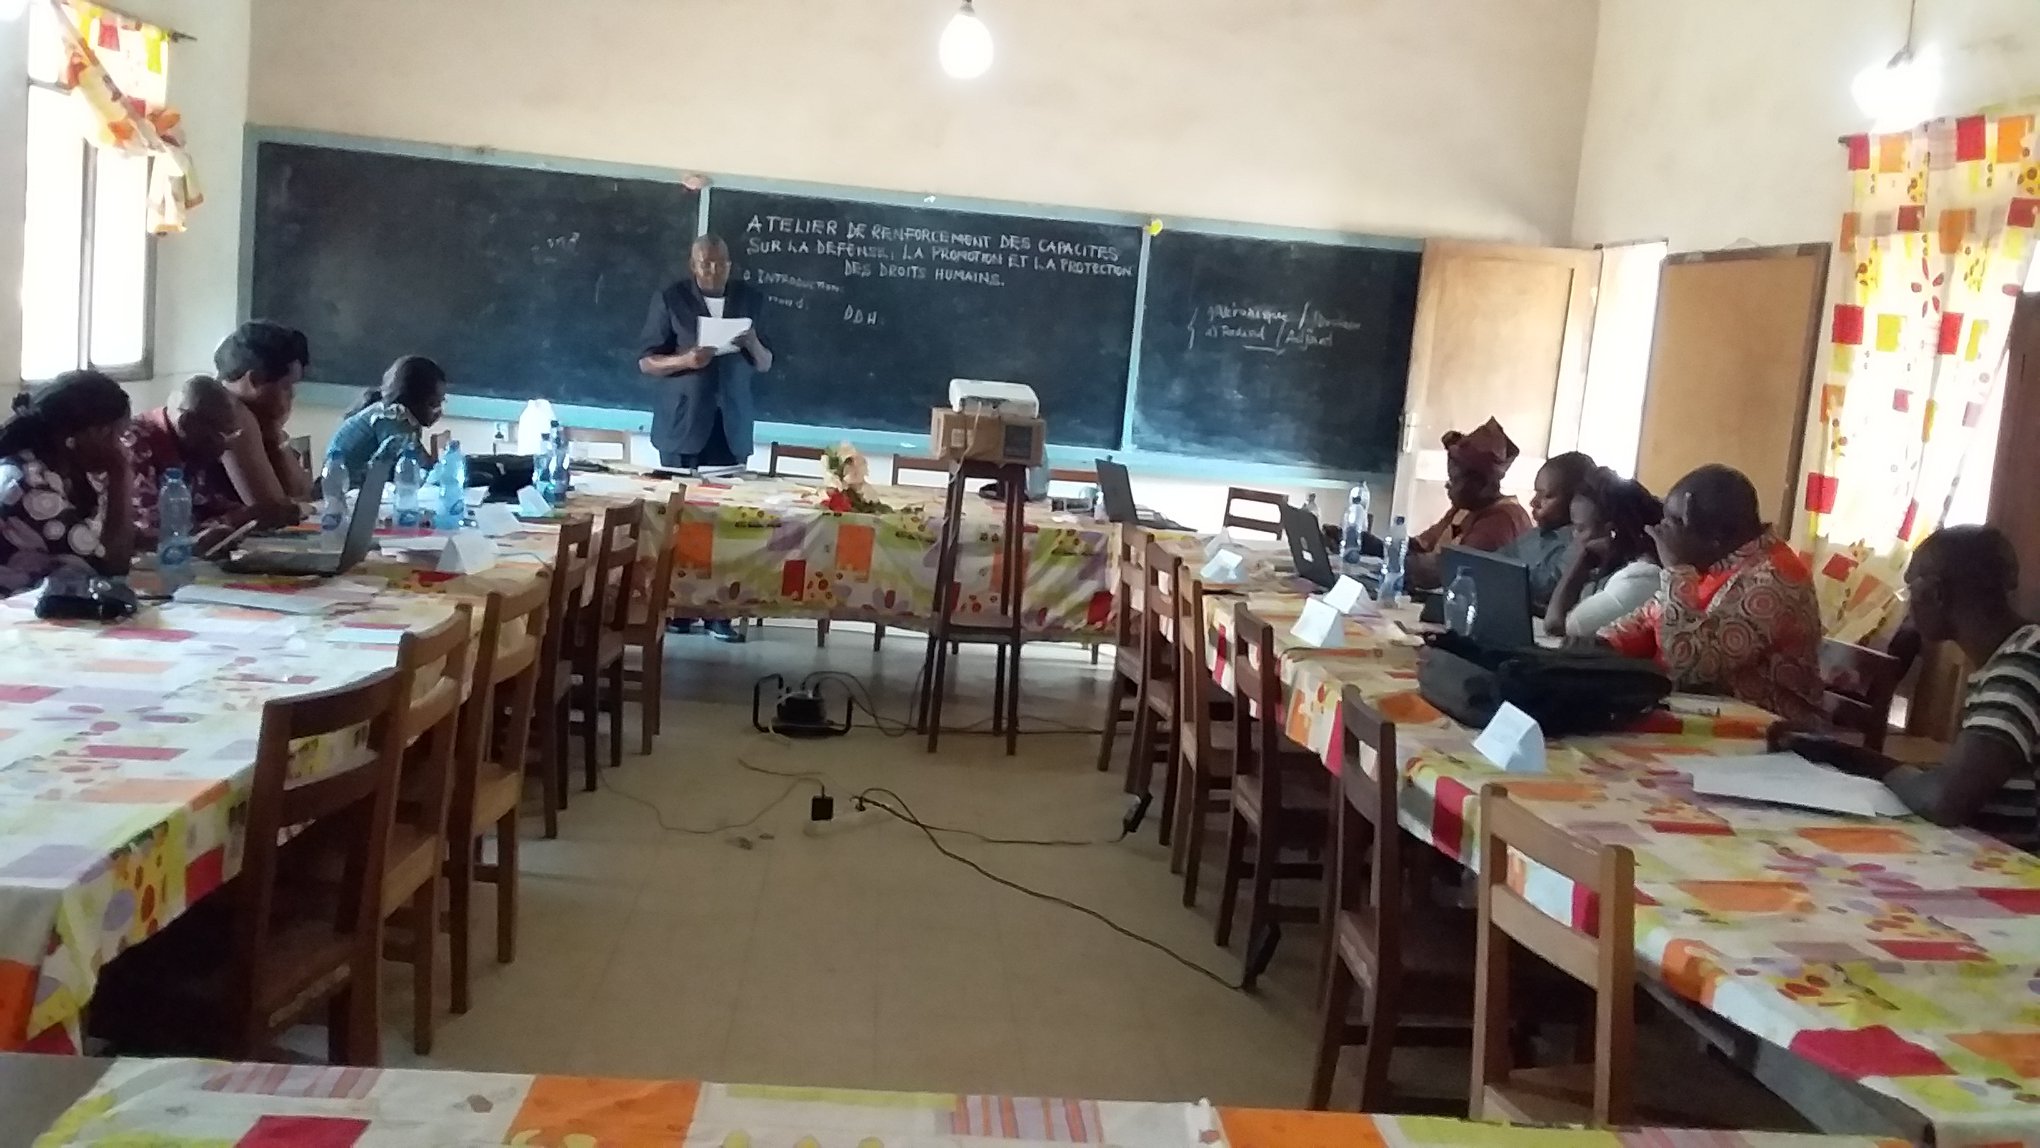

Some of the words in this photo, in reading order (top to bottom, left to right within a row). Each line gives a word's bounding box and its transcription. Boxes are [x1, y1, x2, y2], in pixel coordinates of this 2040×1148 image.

[746, 214, 838, 235] ATELIER
[846, 221, 867, 239] DE
[871, 224, 992, 248] RENFORCEMENT
[1000, 234, 1031, 251] DES
[1038, 239, 1120, 262] CAPACITES
[746, 237, 782, 255] SUR
[788, 240, 809, 253] LA
[902, 243, 924, 260] LA
[932, 245, 1003, 265] PROMOTION
[1008, 253, 1029, 268] ET
[1033, 256, 1057, 270] LA
[1060, 258, 1133, 277] PROTECTION
[844, 259, 872, 277] DES
[879, 262, 927, 279] DROITS
[935, 267, 1005, 286] HUMAINS.
